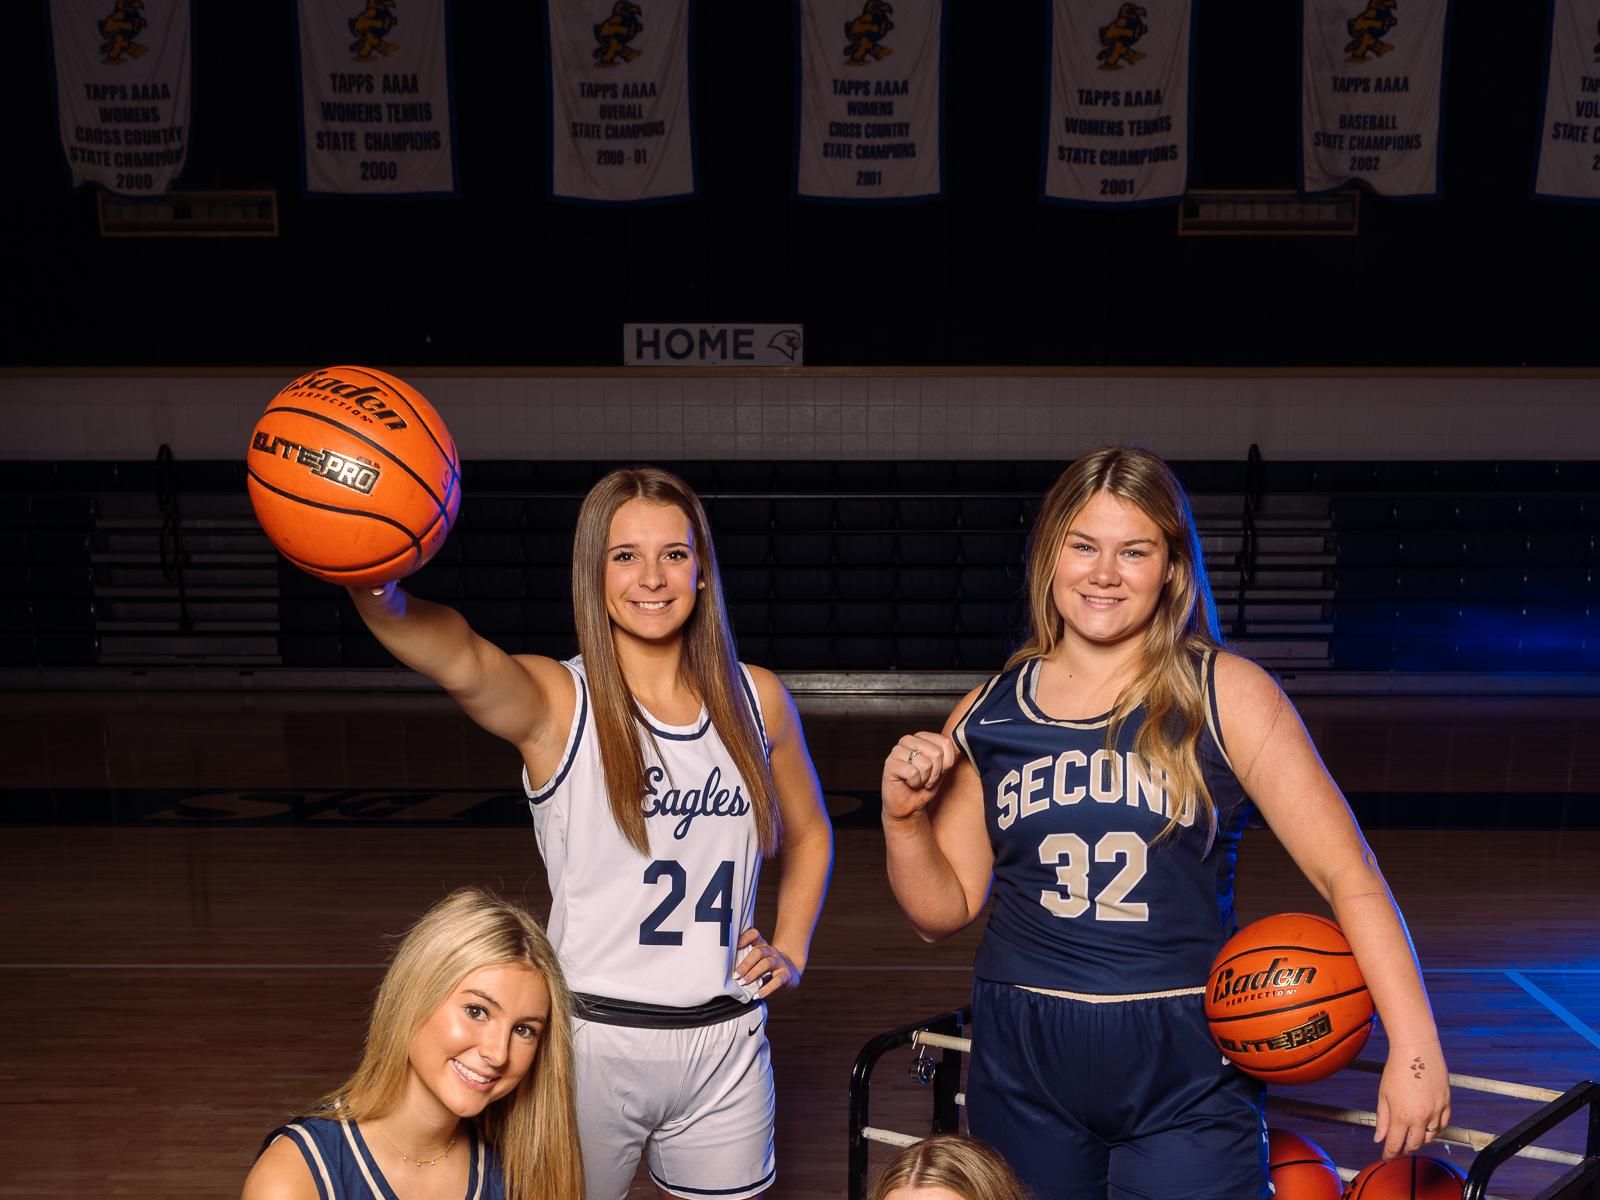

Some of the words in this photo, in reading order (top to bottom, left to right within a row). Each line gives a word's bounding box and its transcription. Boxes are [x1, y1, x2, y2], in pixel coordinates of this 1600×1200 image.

[84, 82, 128, 101] TAPPS
[131, 83, 171, 100] AAAA
[330, 73, 374, 94] TAPPS
[382, 73, 419, 94] AAAA
[580, 81, 618, 99] TAPPS
[622, 81, 657, 99] AAAA
[832, 79, 871, 96] TAPPS
[874, 79, 909, 96] AAAA
[1332, 75, 1370, 93] TAPPS
[1374, 76, 1409, 93] AAAA
[1077, 89, 1121, 107] TAPPS
[1123, 89, 1162, 107] AAAA
[99, 106, 160, 123] WOMENS
[321, 101, 383, 122] WOMENS
[386, 102, 432, 123] TENNIS
[600, 103, 643, 120] OVERALL
[847, 101, 894, 116] WOMENS
[572, 122, 602, 139] STATE
[605, 120, 665, 139] CHAMPIONS
[829, 121, 862, 138] CROSS
[865, 121, 910, 139] COUNTRY
[1065, 116, 1124, 137] WOMENS
[1128, 115, 1172, 137] TENNIS
[1339, 114, 1397, 131] BASEBALL
[1552, 121, 1589, 143] STATE
[75, 126, 122, 146] CROSS
[316, 131, 356, 152] STATE
[364, 130, 441, 152] CHAMPIONS
[1313, 131, 1345, 150] STATE
[1348, 133, 1422, 151] CHAMPIONS
[70, 145, 111, 167] STATE
[597, 150, 624, 166] 2000
[823, 142, 853, 159] STATE
[856, 142, 916, 160] CHAMPIONS
[1057, 145, 1096, 165] STATE
[1100, 144, 1178, 166] CHAMPIONS
[360, 161, 397, 181] 2000
[1349, 156, 1380, 172] 2002
[116, 173, 153, 190] 2000
[856, 170, 882, 186] 2001
[1100, 178, 1134, 196] 2001
[635, 328, 755, 360] HOME
[640, 766, 751, 840] Eagles
[1037, 831, 1150, 922] 32
[638, 859, 736, 947] 24
[1212, 957, 1318, 1005] Baden
[1225, 989, 1297, 1008] PERFECTION
